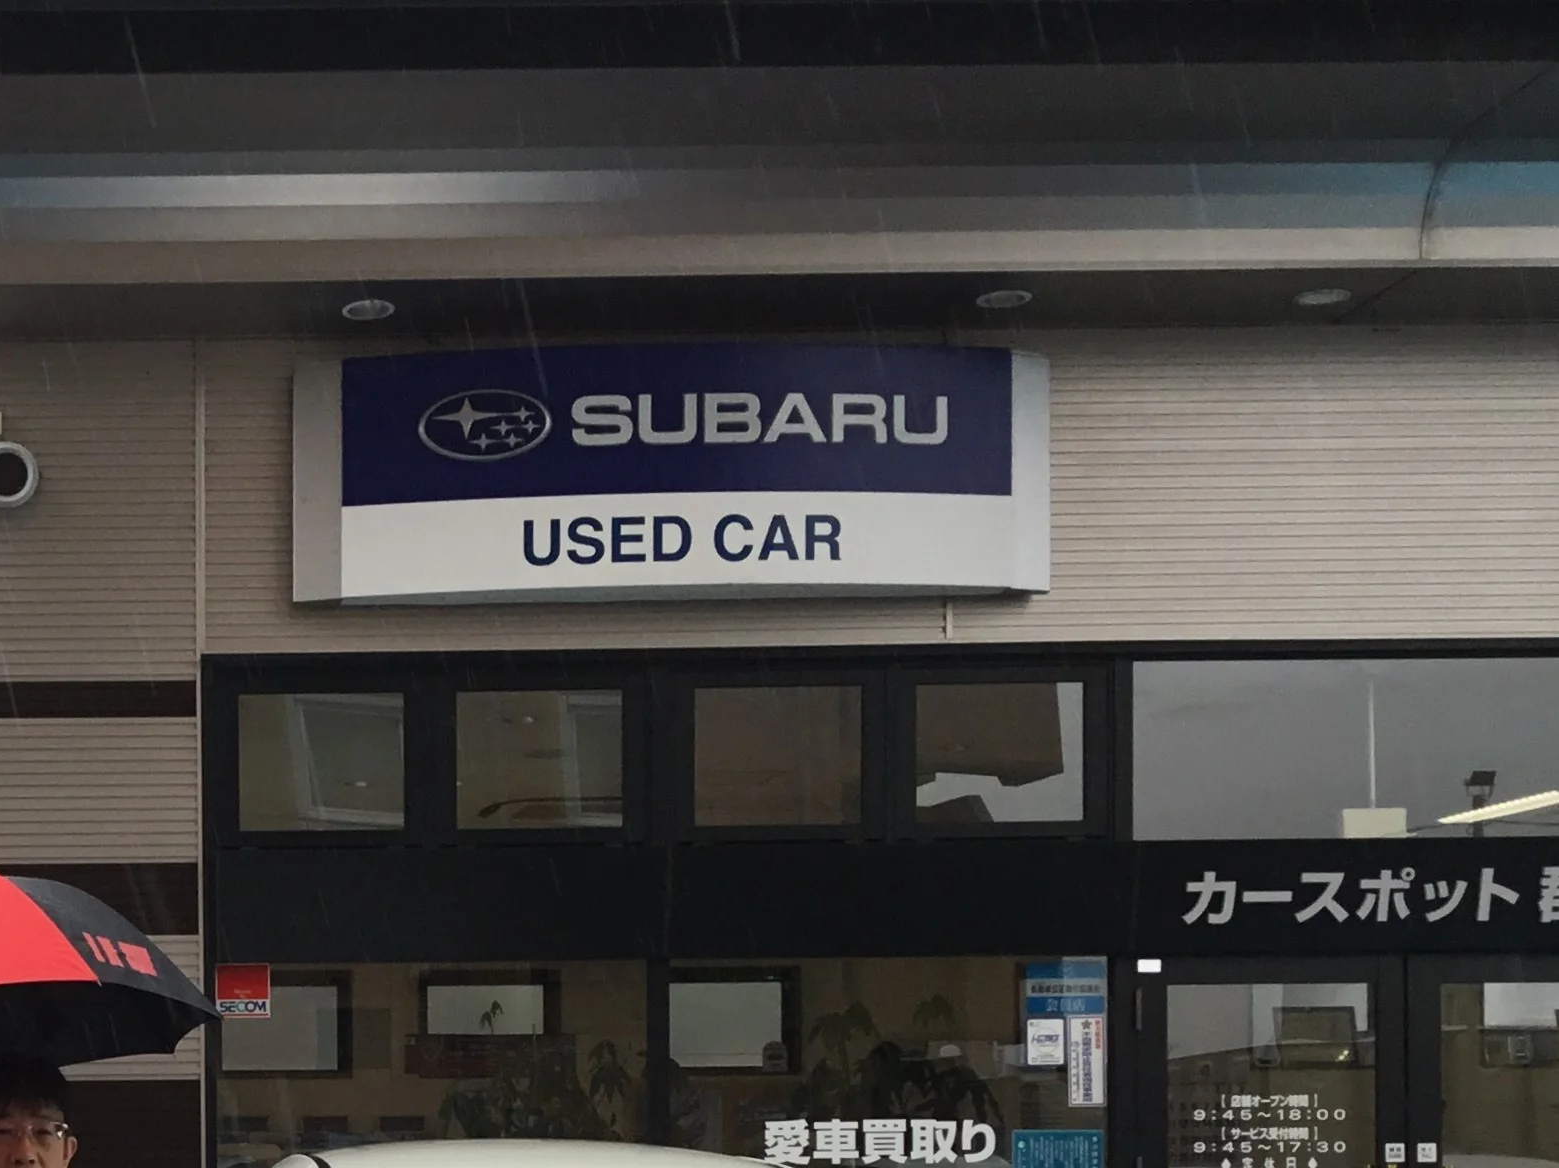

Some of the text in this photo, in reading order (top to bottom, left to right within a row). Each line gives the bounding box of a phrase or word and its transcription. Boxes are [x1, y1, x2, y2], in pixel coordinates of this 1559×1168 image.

[571, 391, 950, 446] SUBARU
[523, 514, 843, 566] USED CAR
[1181, 867, 1520, 924] カースポット
[220, 1000, 266, 1013] SECOM
[764, 1119, 996, 1164] 愛車買取り
